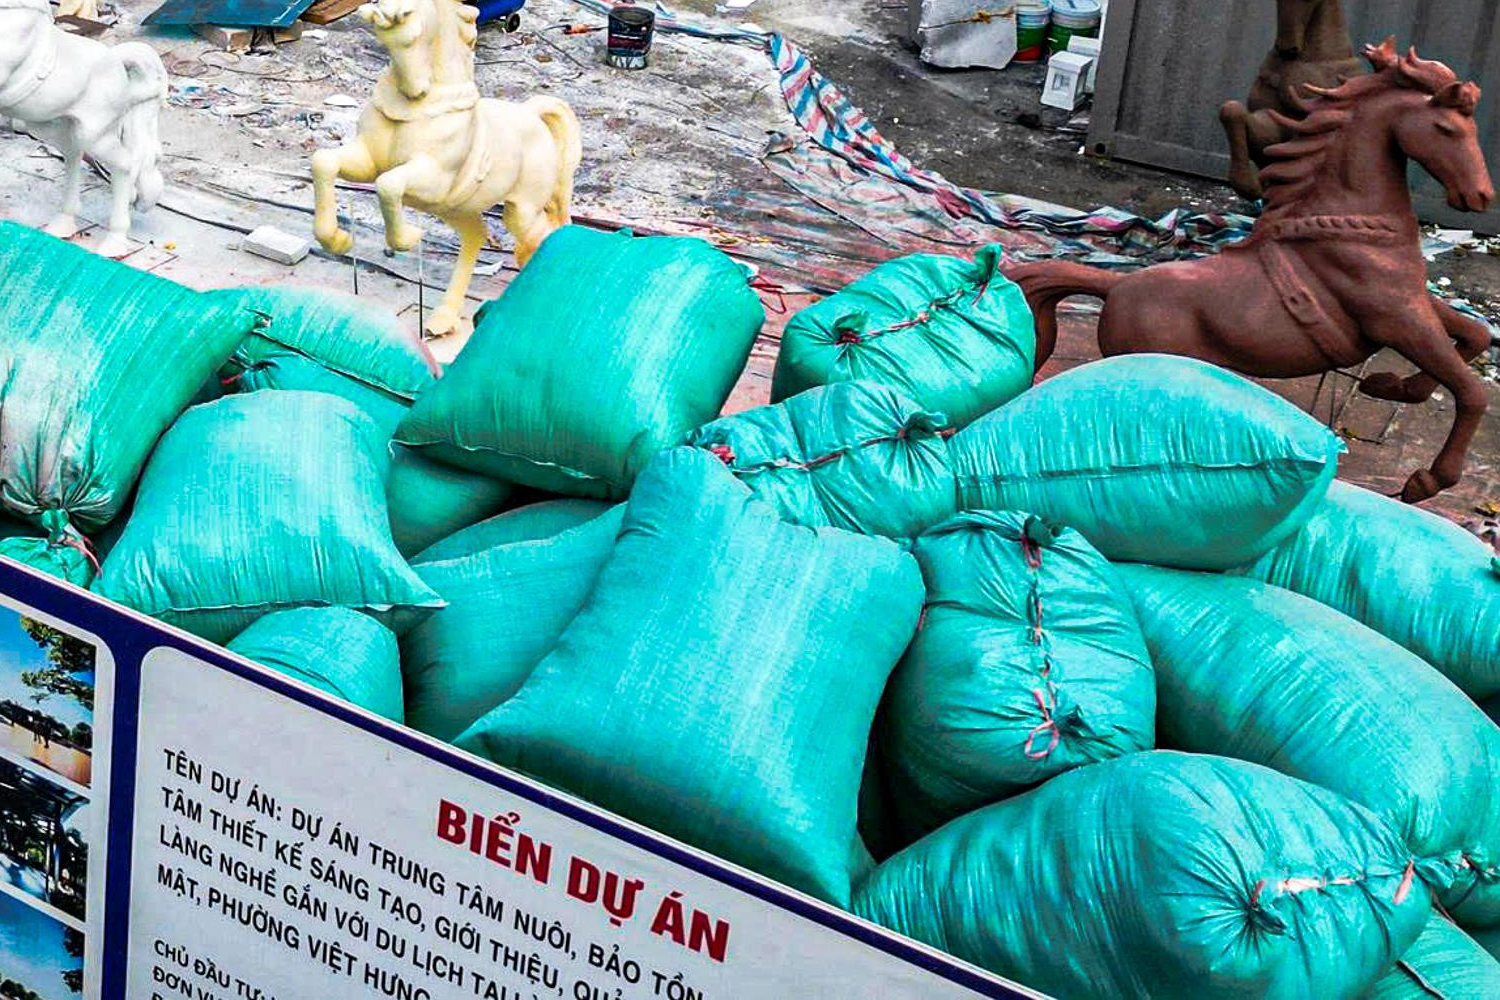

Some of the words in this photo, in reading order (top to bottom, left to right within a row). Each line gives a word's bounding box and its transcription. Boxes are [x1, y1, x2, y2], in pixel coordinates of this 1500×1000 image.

[157, 863, 201, 906] MẬT,
[208, 887, 300, 951] PHƯỜNG
[307, 934, 358, 976] VIỆT
[160, 824, 213, 868] LÀNG
[219, 853, 278, 898] NGHỀ
[283, 883, 327, 922] GẮN
[334, 906, 369, 942] VỚI
[375, 927, 406, 959] DU
[412, 944, 464, 987] LỊCH
[161, 786, 201, 823] TÂM
[209, 808, 268, 853] THIẾT
[274, 840, 305, 871] KẾ
[309, 857, 369, 902] SÁNG
[377, 887, 426, 933] TẠO,
[434, 915, 481, 954] GIỚI
[489, 938, 564, 998] THIỆU,
[163, 748, 202, 785] TÊN
[210, 770, 241, 804] DỰ
[246, 784, 282, 822] ÁN:
[291, 808, 323, 841] DỰ
[328, 822, 359, 857] ÁN
[368, 842, 445, 896] TRUNG
[455, 881, 504, 923] TÂM
[513, 908, 577, 962] NUÔI,
[588, 943, 641, 985] BẢO
[436, 798, 552, 884] BIỂN
[566, 855, 645, 928] DỰ
[650, 890, 730, 963] ÁN
[152, 965, 193, 999] ĐƠN
[153, 939, 189, 968] CHỦ
[193, 957, 231, 989] ĐẦU
